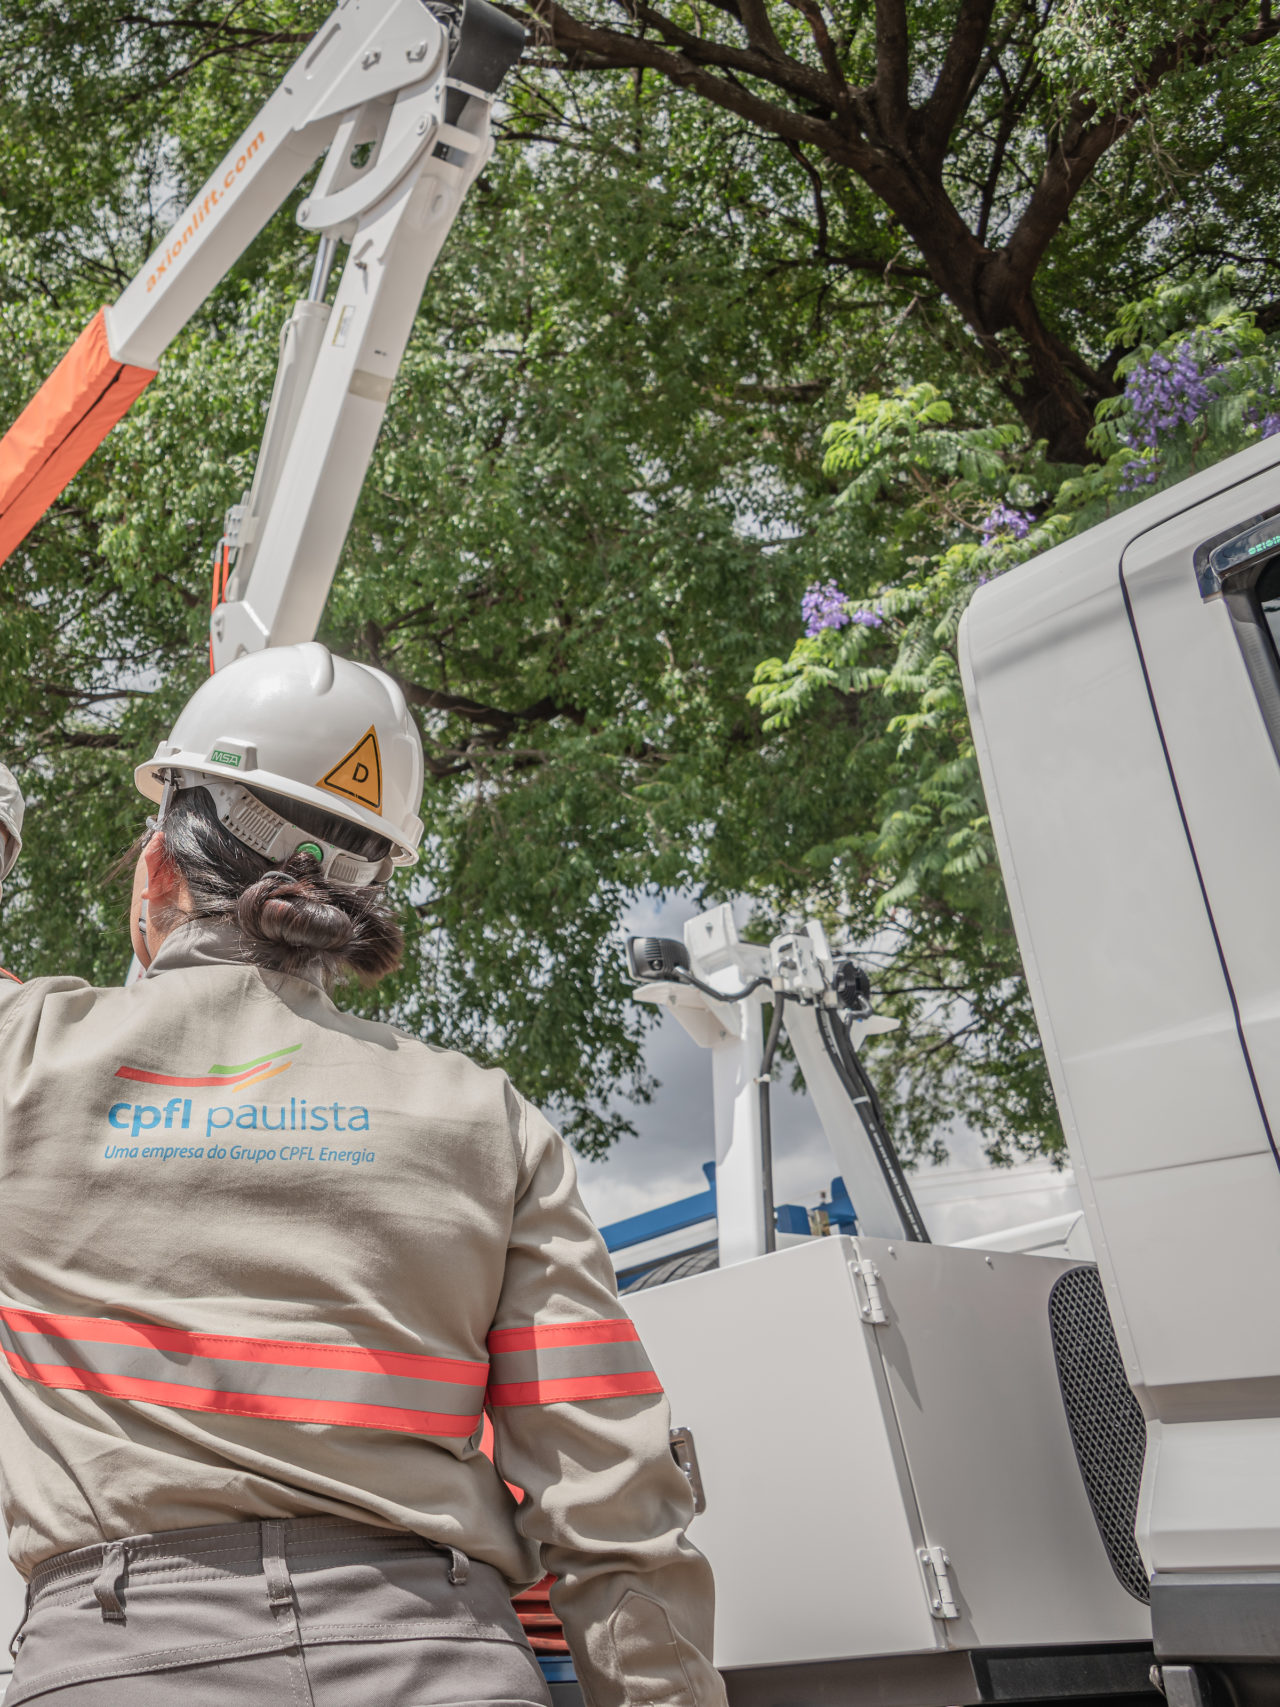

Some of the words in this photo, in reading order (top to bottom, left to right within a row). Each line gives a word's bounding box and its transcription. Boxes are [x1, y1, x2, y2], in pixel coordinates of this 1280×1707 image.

[146, 131, 266, 293] axionlift.com
[211, 750, 240, 767] MSA
[352, 762, 369, 783] D
[108, 1098, 192, 1137] cpfl
[206, 1097, 370, 1137] paulista
[104, 1145, 139, 1159] Uma
[141, 1146, 204, 1161] empresa
[207, 1144, 227, 1159] do
[230, 1145, 276, 1163] Grupo
[279, 1146, 315, 1160] CPFL
[318, 1147, 375, 1165] Energia
